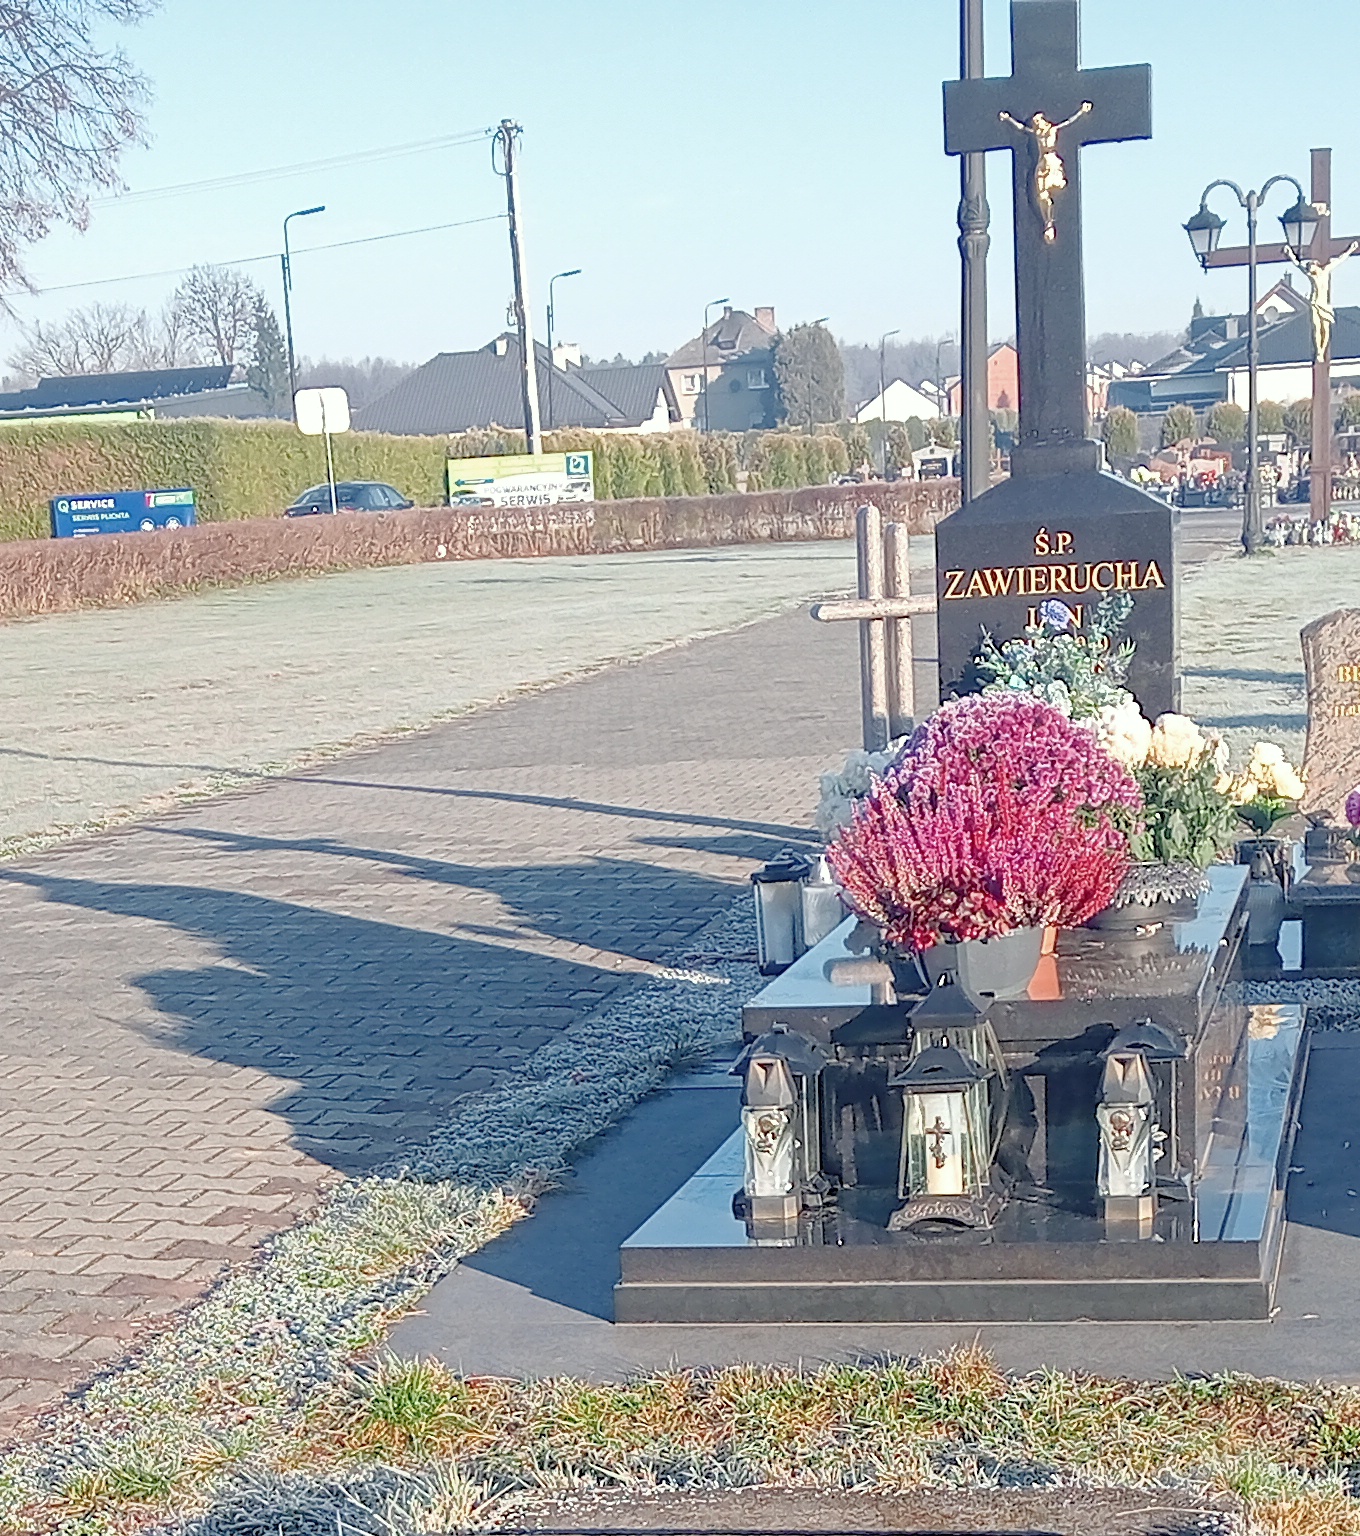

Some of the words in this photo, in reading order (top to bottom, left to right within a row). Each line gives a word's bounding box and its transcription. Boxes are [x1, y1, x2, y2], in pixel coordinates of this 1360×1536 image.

[70, 499, 115, 510] SERVICE
[500, 494, 551, 506] SERWIS
[1034, 527, 1074, 556] Ś.P.
[943, 560, 1165, 600] ZAWIERUCHA
